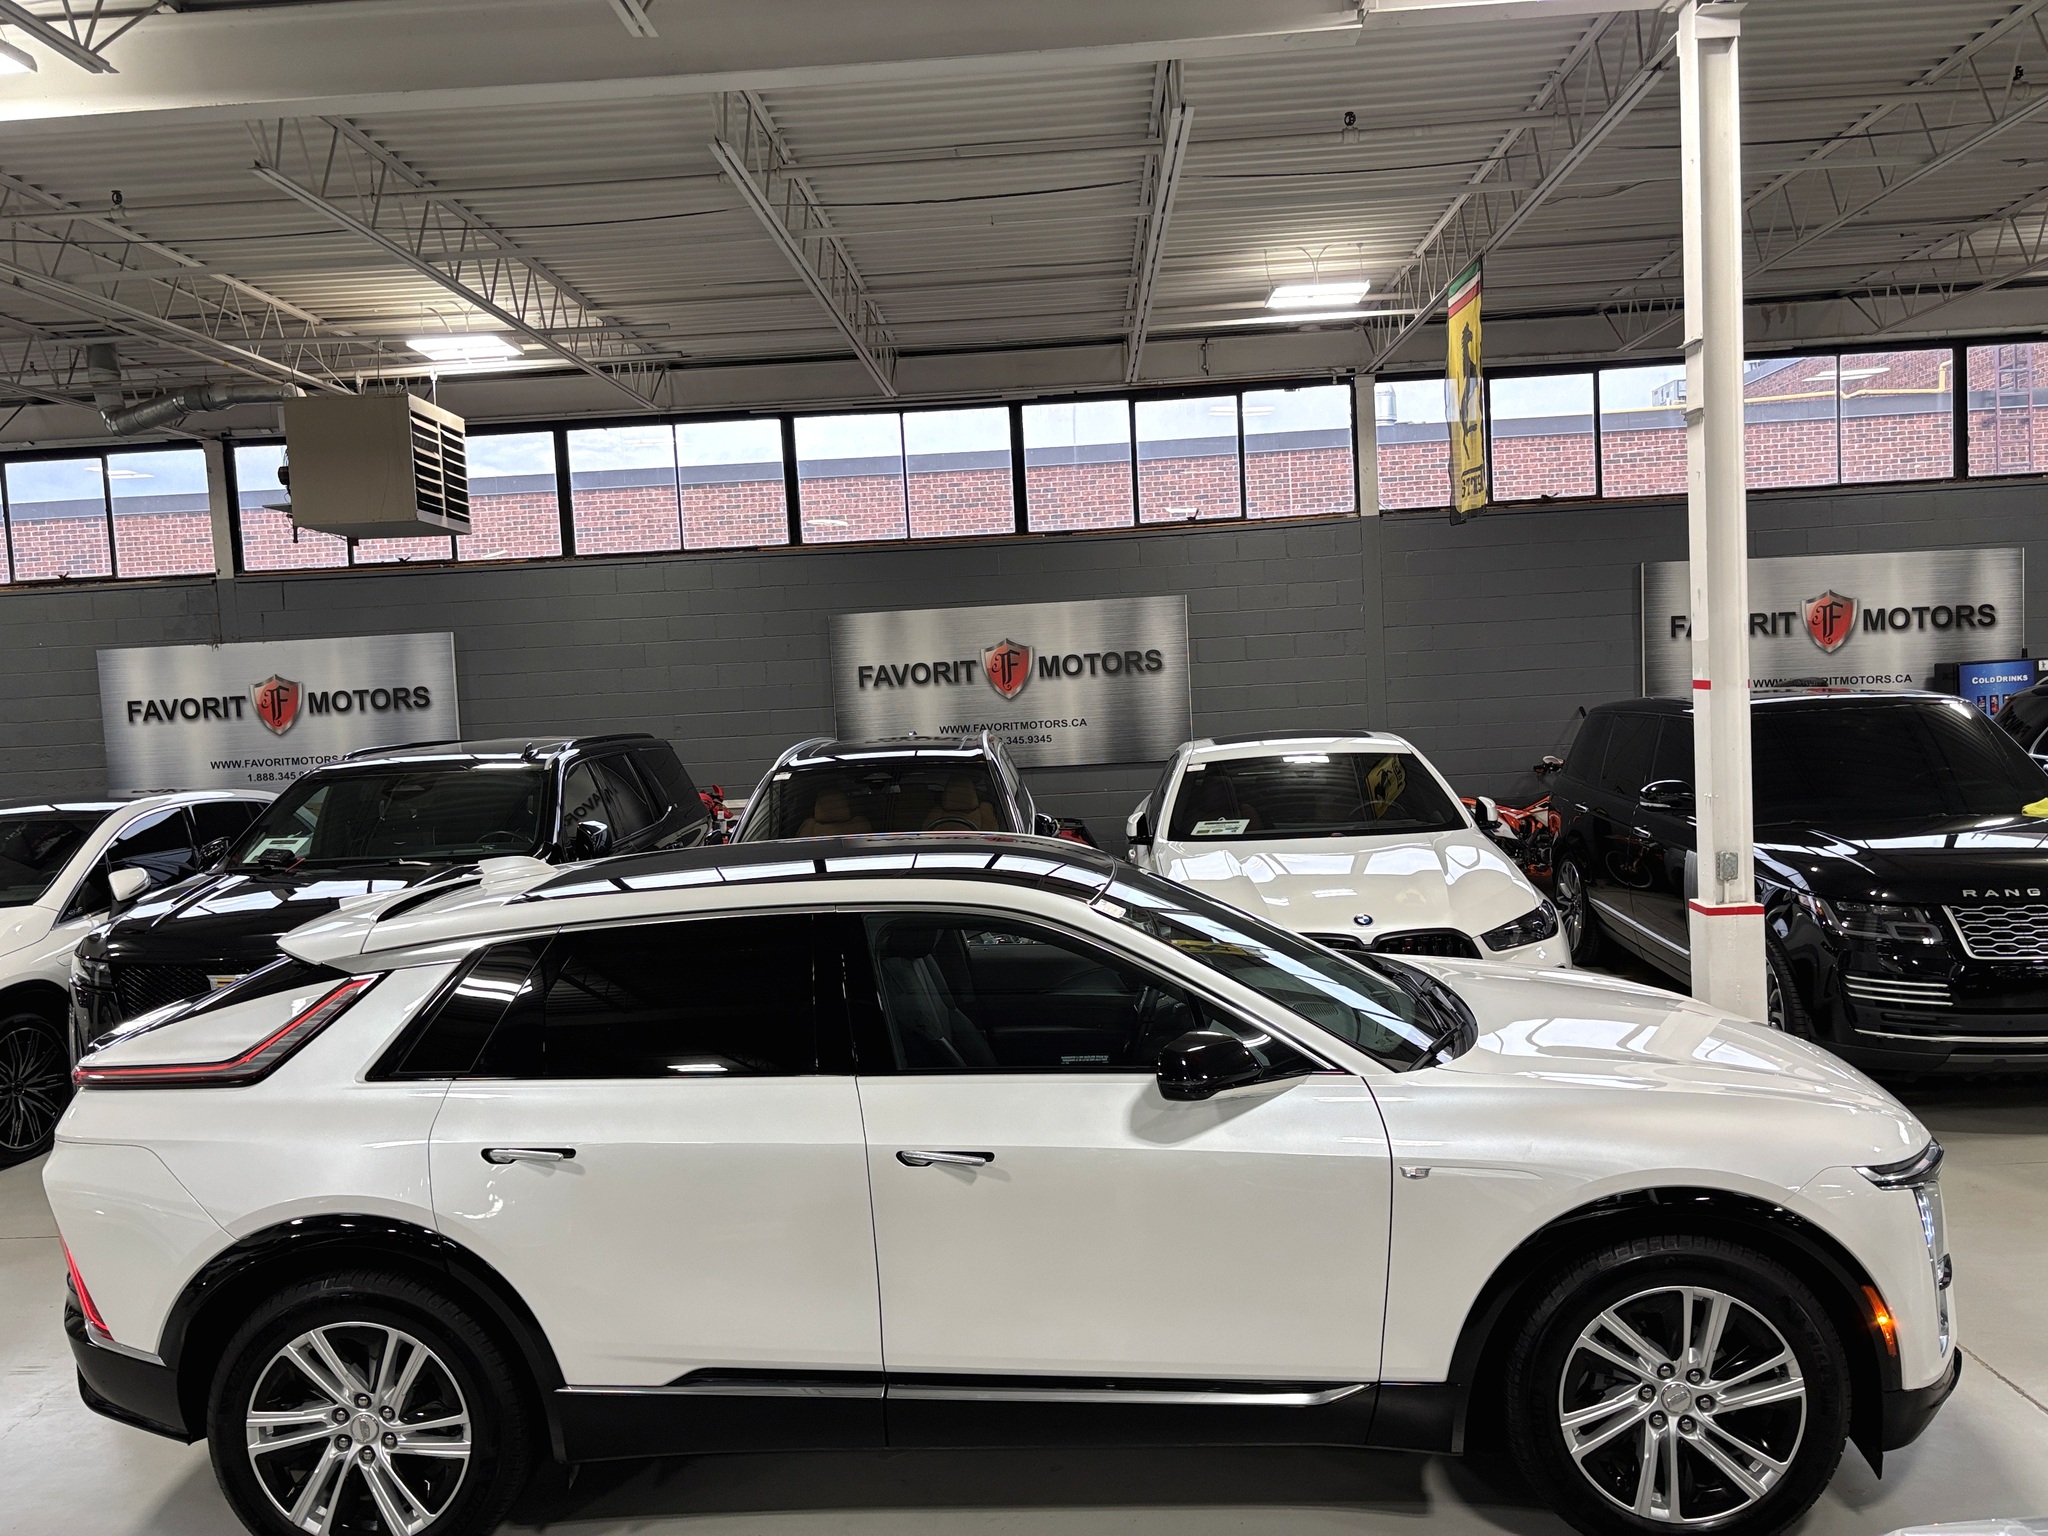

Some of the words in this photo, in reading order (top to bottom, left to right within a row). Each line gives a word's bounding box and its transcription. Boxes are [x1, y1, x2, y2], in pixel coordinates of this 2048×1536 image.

[1670, 611, 1796, 638] FRIT
[1863, 604, 1996, 631] MOTORS
[858, 660, 977, 687] FAVORIT
[1038, 650, 1163, 678] MOTORS
[127, 696, 247, 722] FAVORIT
[308, 686, 430, 713] MOTORS
[939, 718, 1087, 735] WWW.FAVORITMOTORS.CA
[1962, 887, 2048, 898] RANG
